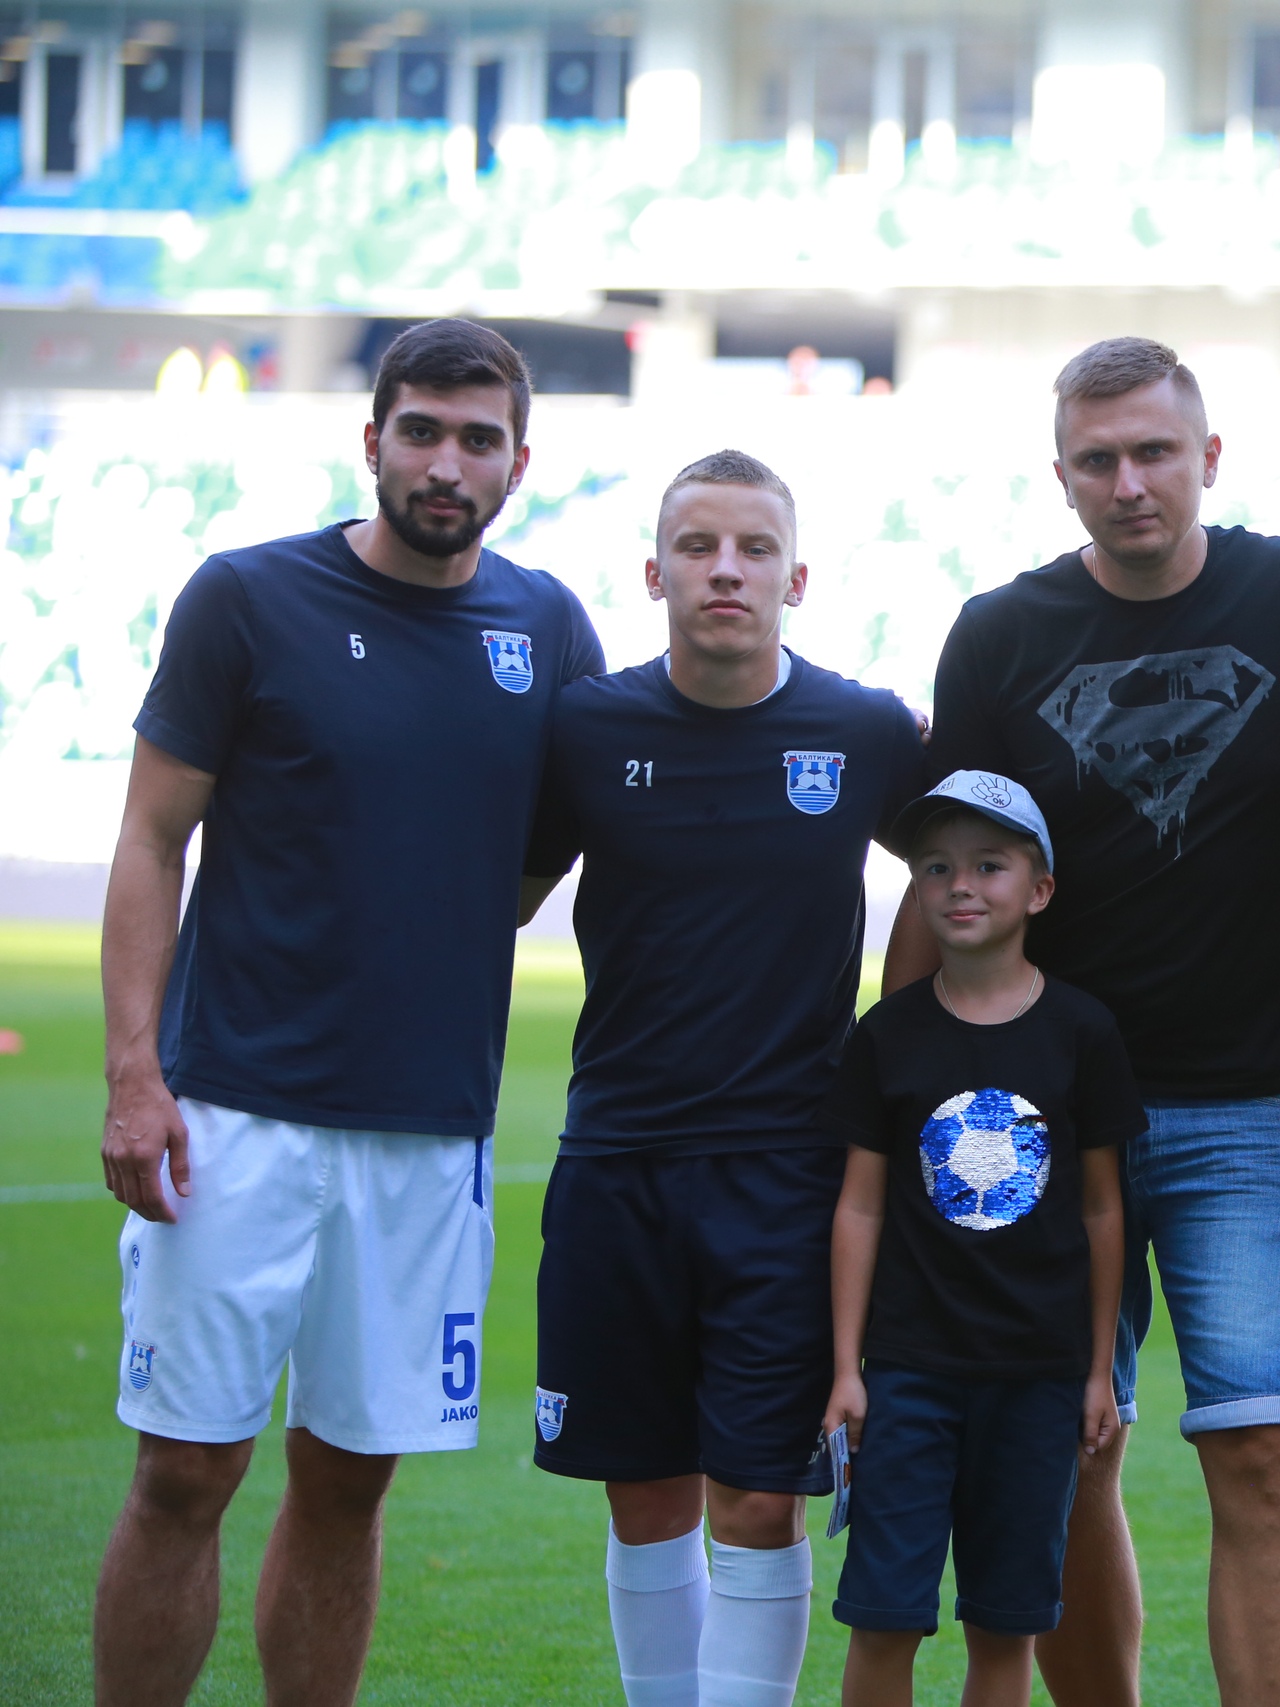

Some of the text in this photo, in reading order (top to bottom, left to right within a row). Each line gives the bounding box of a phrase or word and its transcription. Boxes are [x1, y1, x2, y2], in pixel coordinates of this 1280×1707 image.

[349, 633, 366, 660] 5
[494, 634, 522, 643] БАЛТИКА
[797, 754, 832, 762] БАЛТИКА
[625, 759, 654, 788] 21
[442, 1312, 476, 1401] 5
[440, 1405, 479, 1423] JAKO
